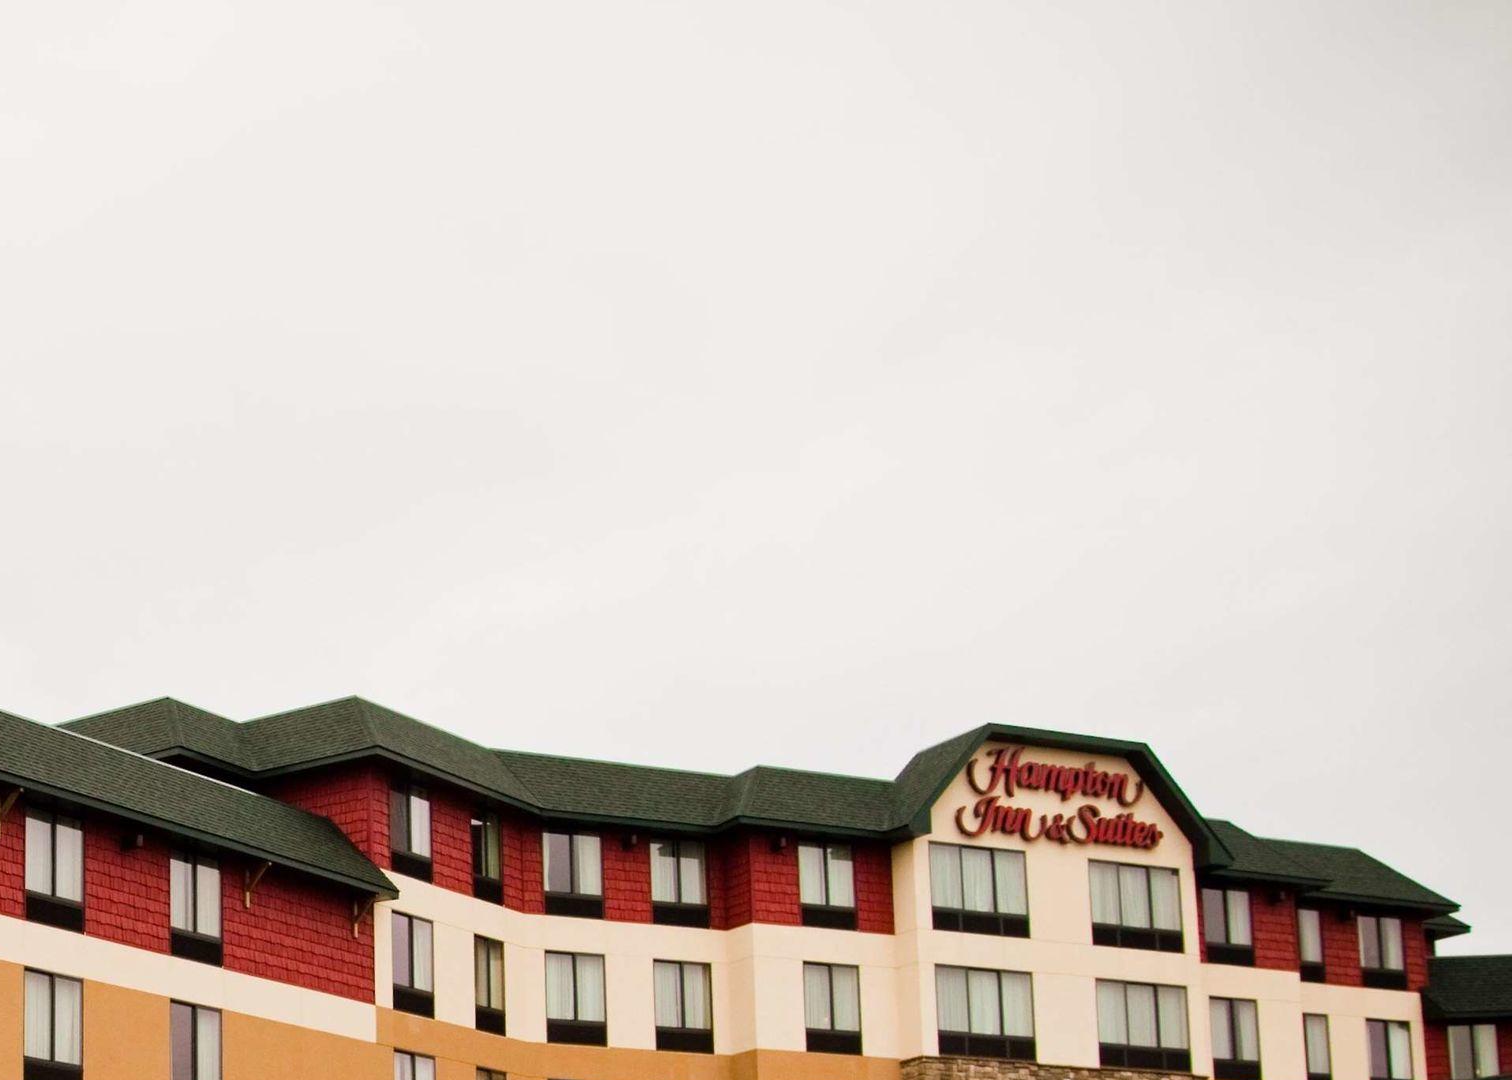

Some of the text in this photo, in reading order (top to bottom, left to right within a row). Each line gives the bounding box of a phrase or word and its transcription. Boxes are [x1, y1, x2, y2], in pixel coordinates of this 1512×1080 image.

[965, 746, 1144, 808] Hampton
[955, 796, 1164, 850] Inn & Suites
